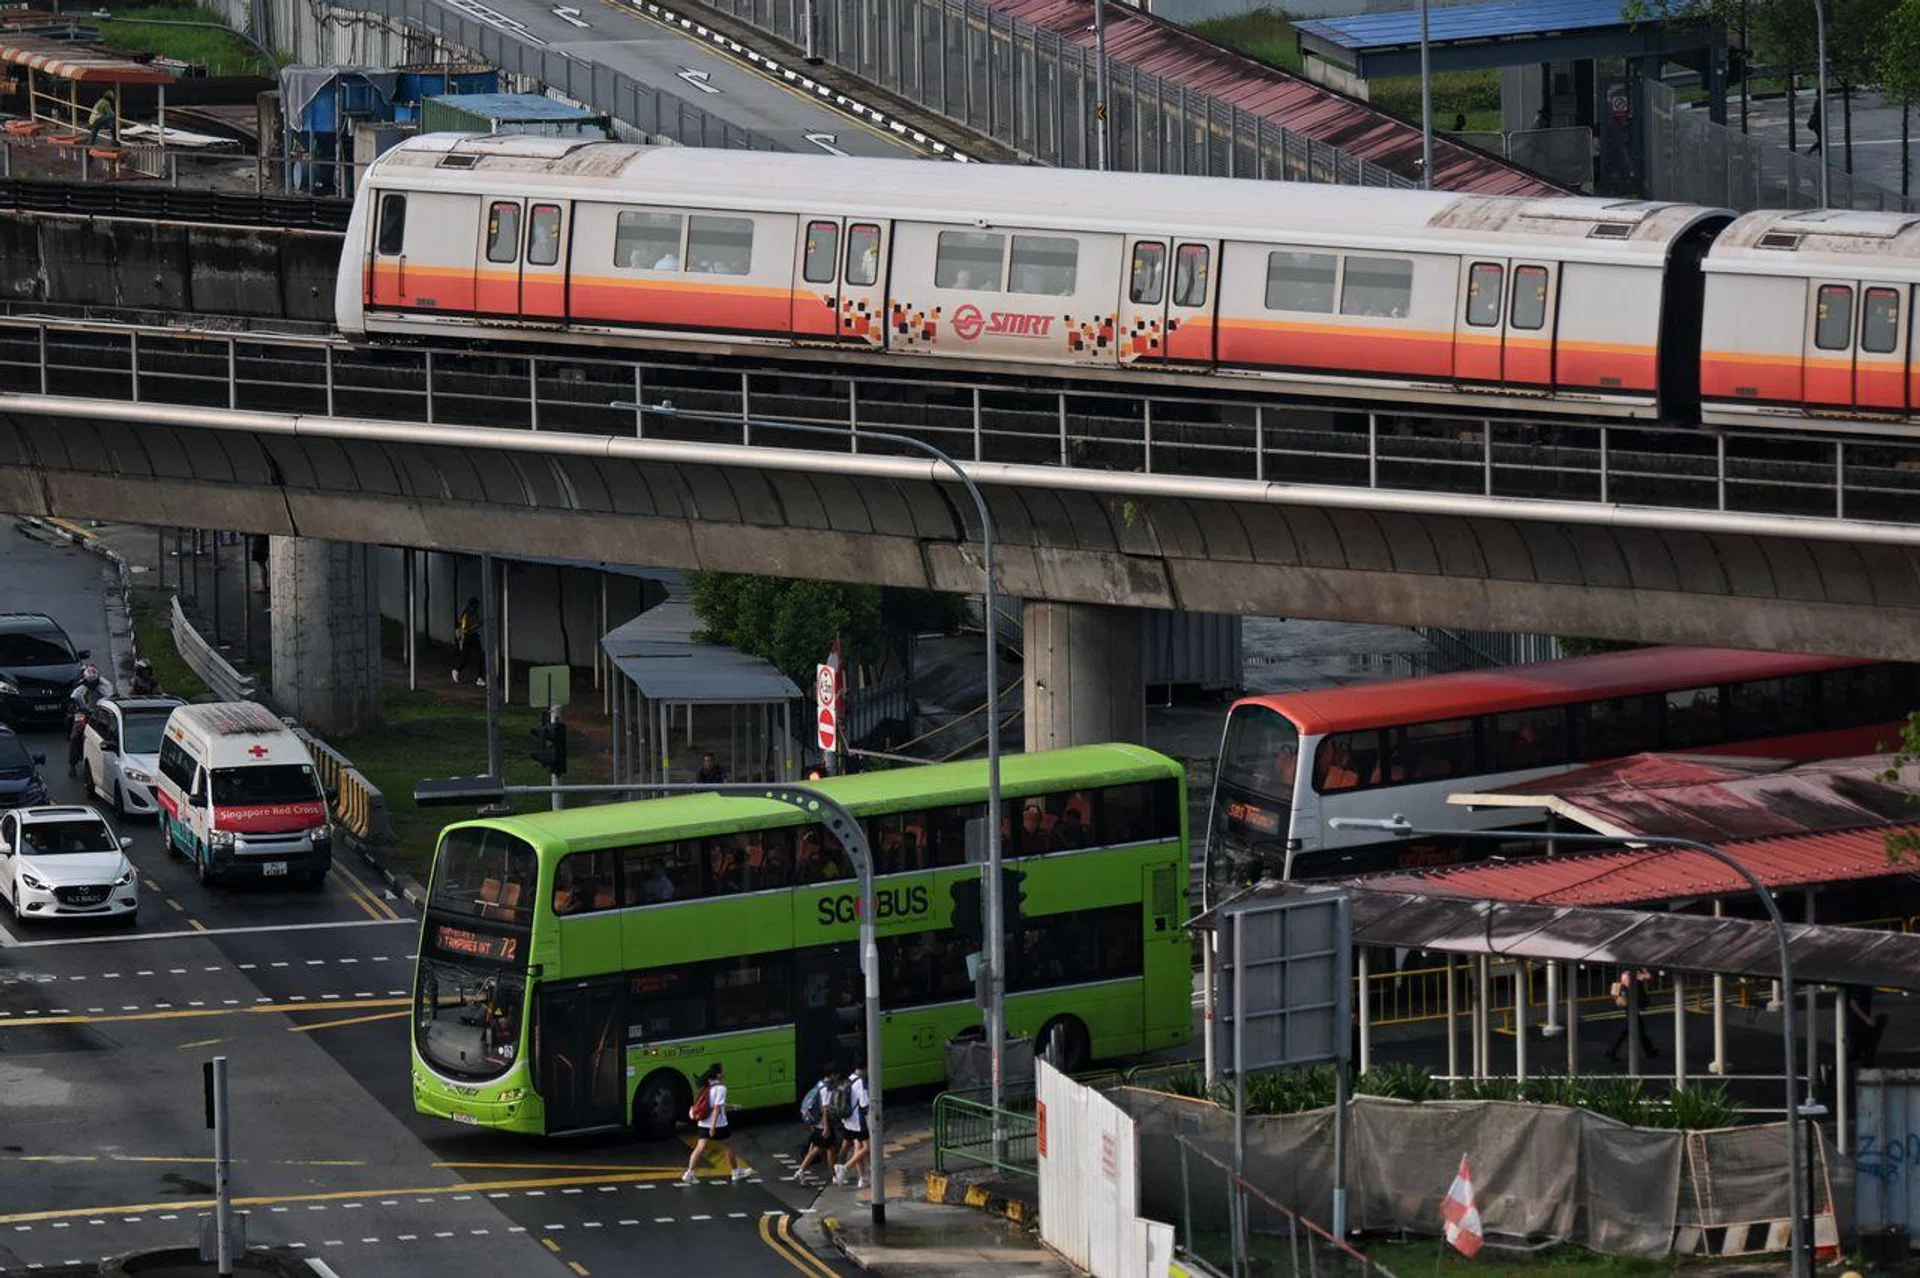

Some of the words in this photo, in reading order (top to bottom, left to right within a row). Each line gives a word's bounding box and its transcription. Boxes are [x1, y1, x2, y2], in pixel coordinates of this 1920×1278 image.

[984, 312, 1055, 337] SMRT
[220, 807, 270, 821] Singapore
[272, 806, 291, 816] Red
[293, 805, 319, 815] Cross
[818, 894, 855, 926] SG
[876, 885, 929, 919] BUS
[499, 936, 517, 961] 72
